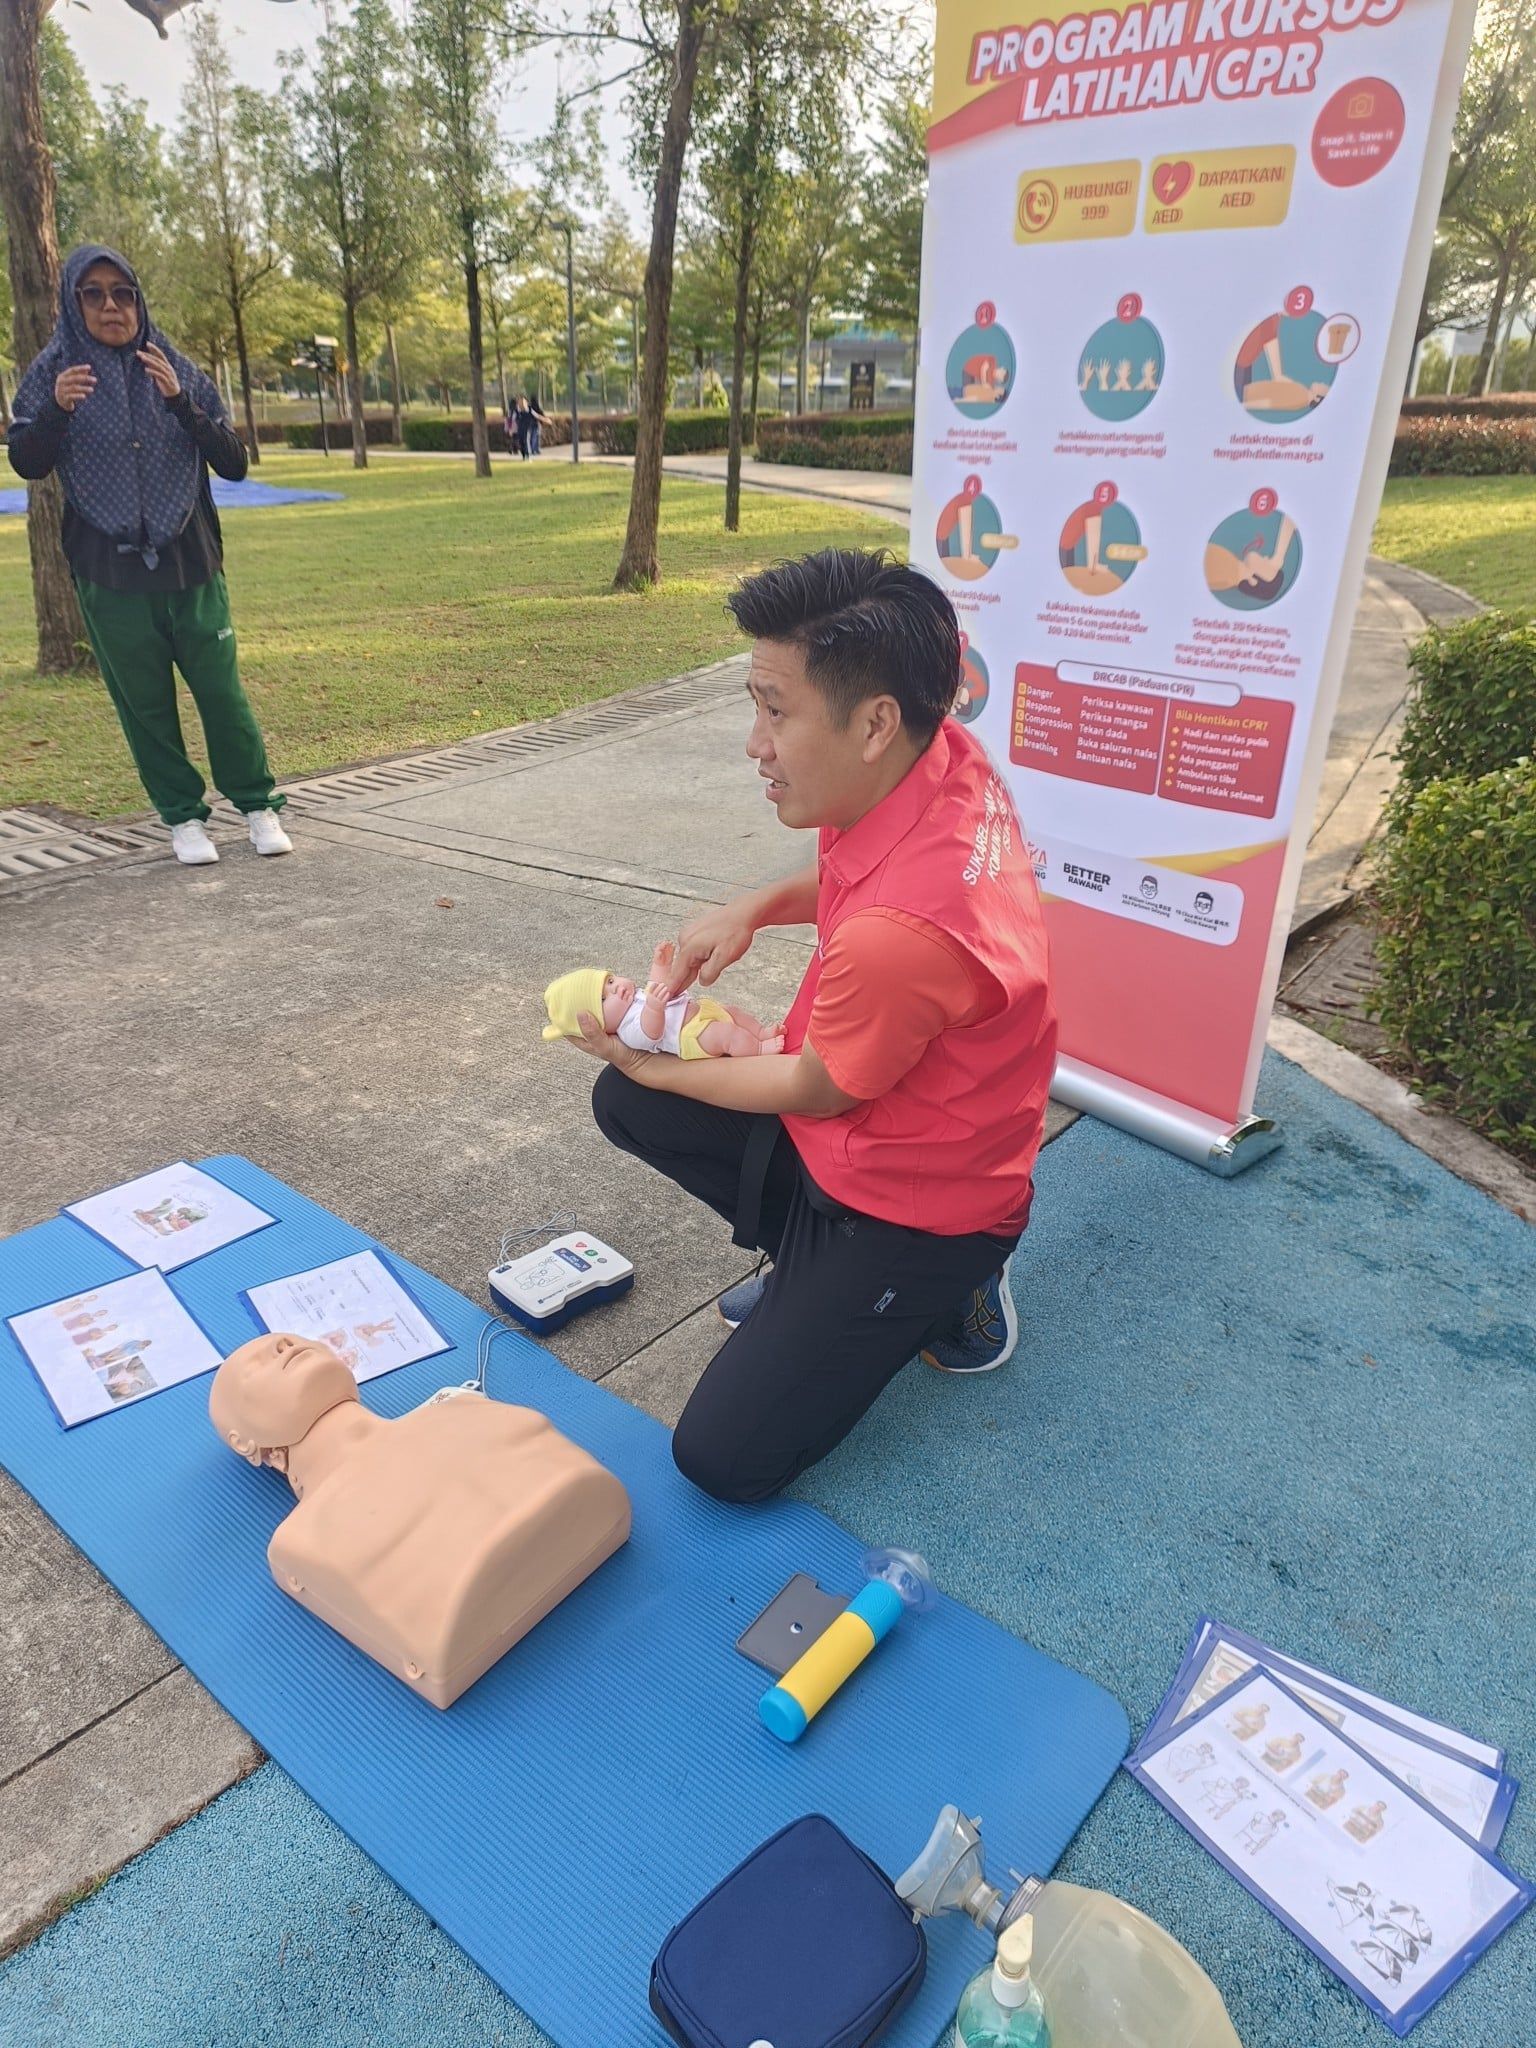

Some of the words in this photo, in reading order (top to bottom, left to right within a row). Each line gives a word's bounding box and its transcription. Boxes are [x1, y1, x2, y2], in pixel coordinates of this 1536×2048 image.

[973, 3, 1193, 79] PROGRAM
[1022, 53, 1210, 121] LATIHAN
[1214, 41, 1318, 96] CPR
[1320, 135, 1344, 147] Snap
[1359, 131, 1383, 142] Save
[1328, 148, 1350, 159] Save
[1360, 145, 1379, 156] Life
[1199, 166, 1285, 187] DAPATKAN
[1064, 180, 1132, 200] HUBUNGI
[1219, 191, 1255, 209] AED
[1081, 205, 1109, 220] 999
[1152, 208, 1183, 225] AED
[1292, 292, 1306, 310] 3
[1256, 494, 1270, 510] 6
[1027, 686, 1053, 699] Danger
[1093, 671, 1127, 685] DRCAB
[1129, 676, 1169, 692] (Paduan
[1170, 684, 1196, 697] CPR)
[1026, 700, 1061, 714] Response
[1082, 696, 1114, 709] Periksa
[1115, 701, 1154, 715] kawasan
[1024, 712, 1073, 730] Compression
[1080, 710, 1112, 723] Periksa
[1114, 716, 1148, 730] mangsa
[1175, 709, 1194, 722] Bila
[1194, 713, 1240, 729] Hentikan
[1023, 726, 1048, 740] Airway
[1079, 723, 1104, 736] Tekan
[1105, 728, 1128, 740] dada
[1183, 727, 1202, 739] Nadi
[1203, 730, 1220, 741] dan
[1221, 733, 1245, 744] nafas
[1023, 738, 1058, 756] Breathing
[1077, 737, 1099, 749] Buka
[1100, 741, 1133, 755] saluran
[1133, 747, 1158, 760] nafas
[1181, 741, 1231, 758] Penyelamat
[1231, 747, 1252, 760] letih
[1076, 750, 1112, 765] Bantuan
[1112, 757, 1137, 770] nafas
[1179, 754, 1194, 765] Ada
[1195, 757, 1240, 773] pengganti
[1177, 767, 1217, 782] Ambulans
[1218, 773, 1237, 785] tiba
[1176, 780, 1205, 796] Tempat
[1206, 785, 1229, 798] tidak
[1229, 790, 1264, 804] selamat
[1063, 862, 1111, 886] BETTER
[1068, 876, 1103, 892] RAWANG
